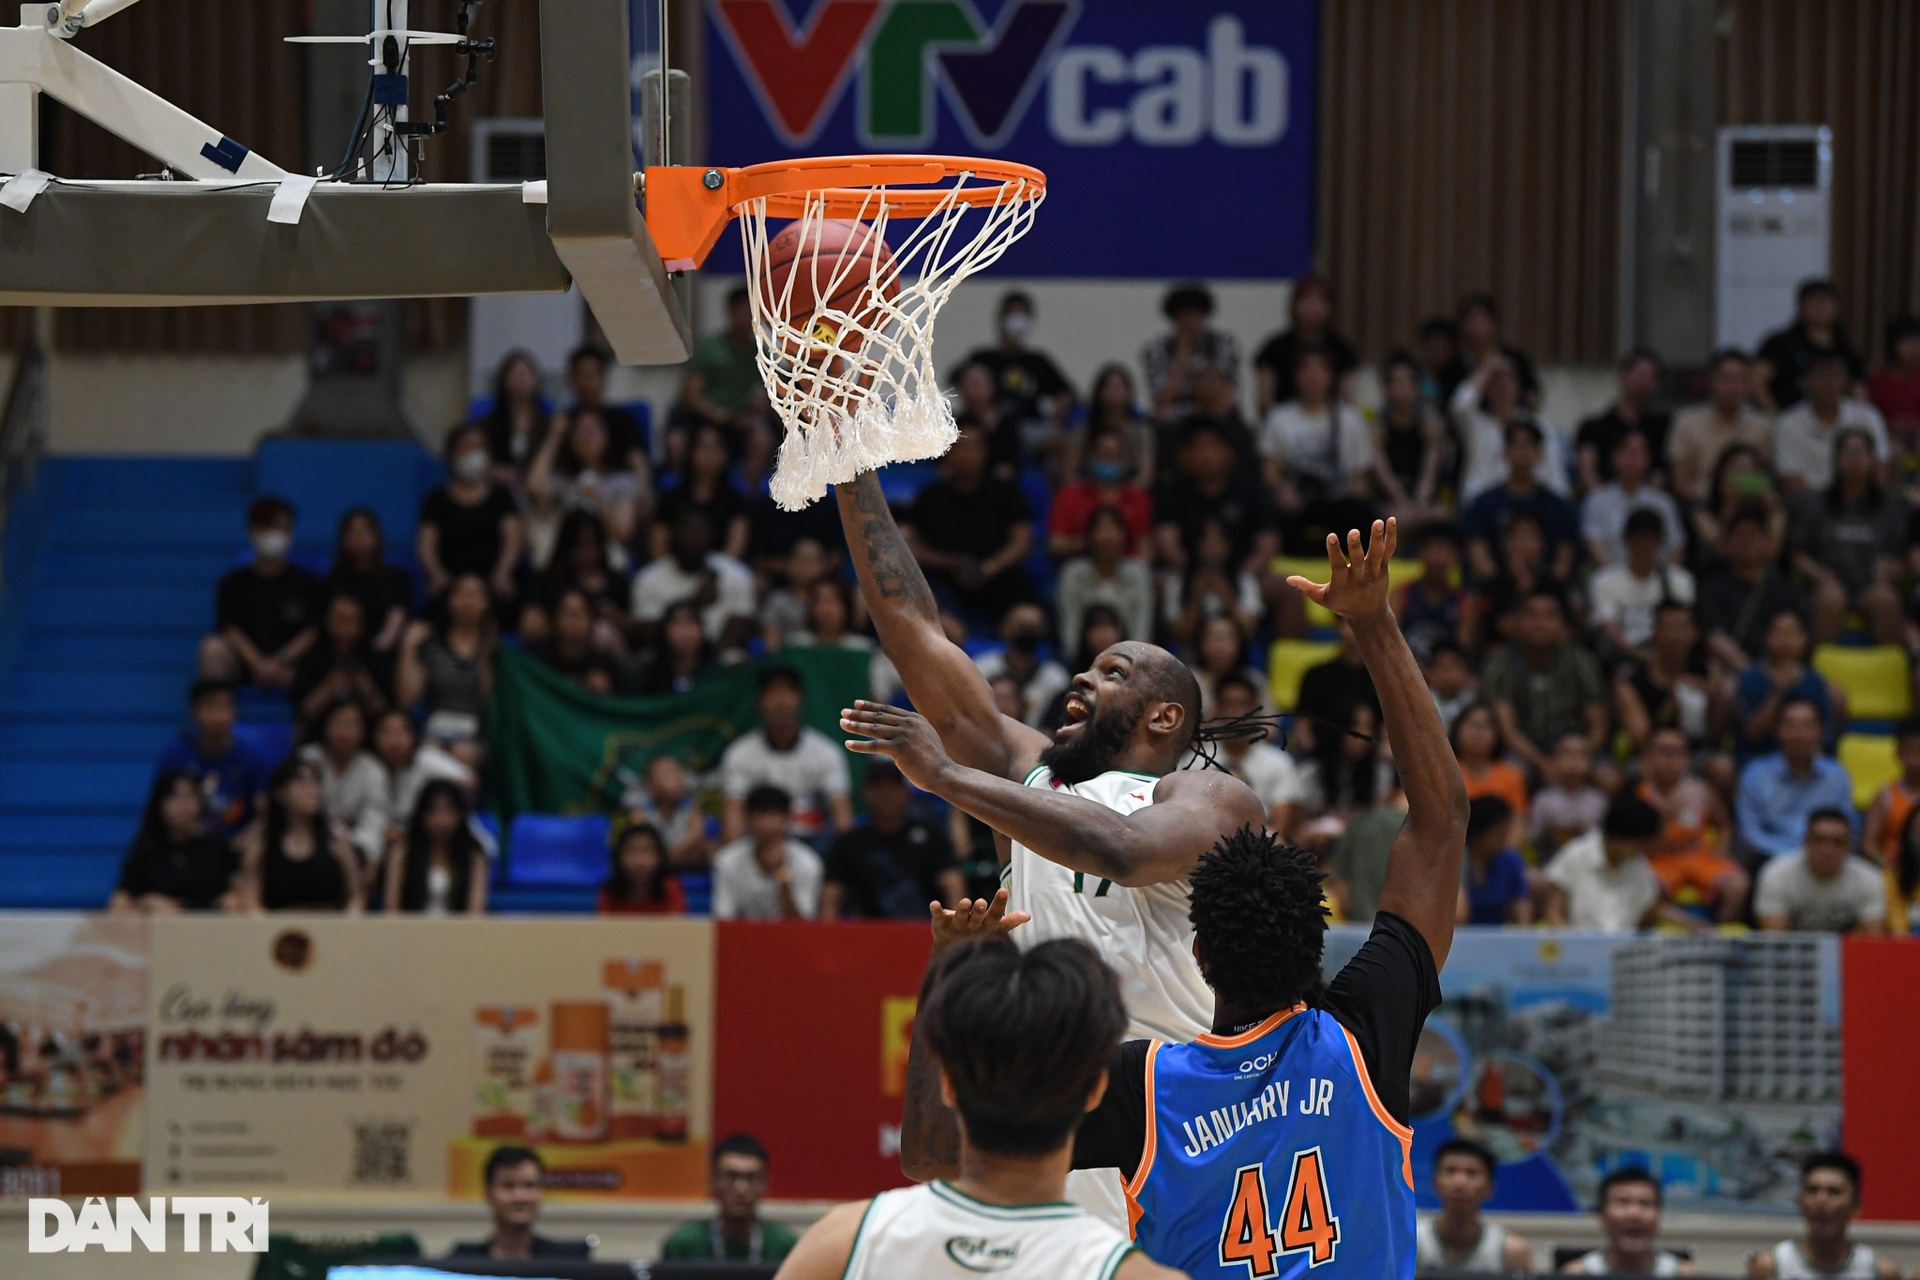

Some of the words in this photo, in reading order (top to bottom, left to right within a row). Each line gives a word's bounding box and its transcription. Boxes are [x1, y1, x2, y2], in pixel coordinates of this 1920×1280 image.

[1182, 1080, 1290, 1158] JANUARY
[1300, 1078, 1334, 1117] JR
[1218, 1145, 1341, 1280] 44
